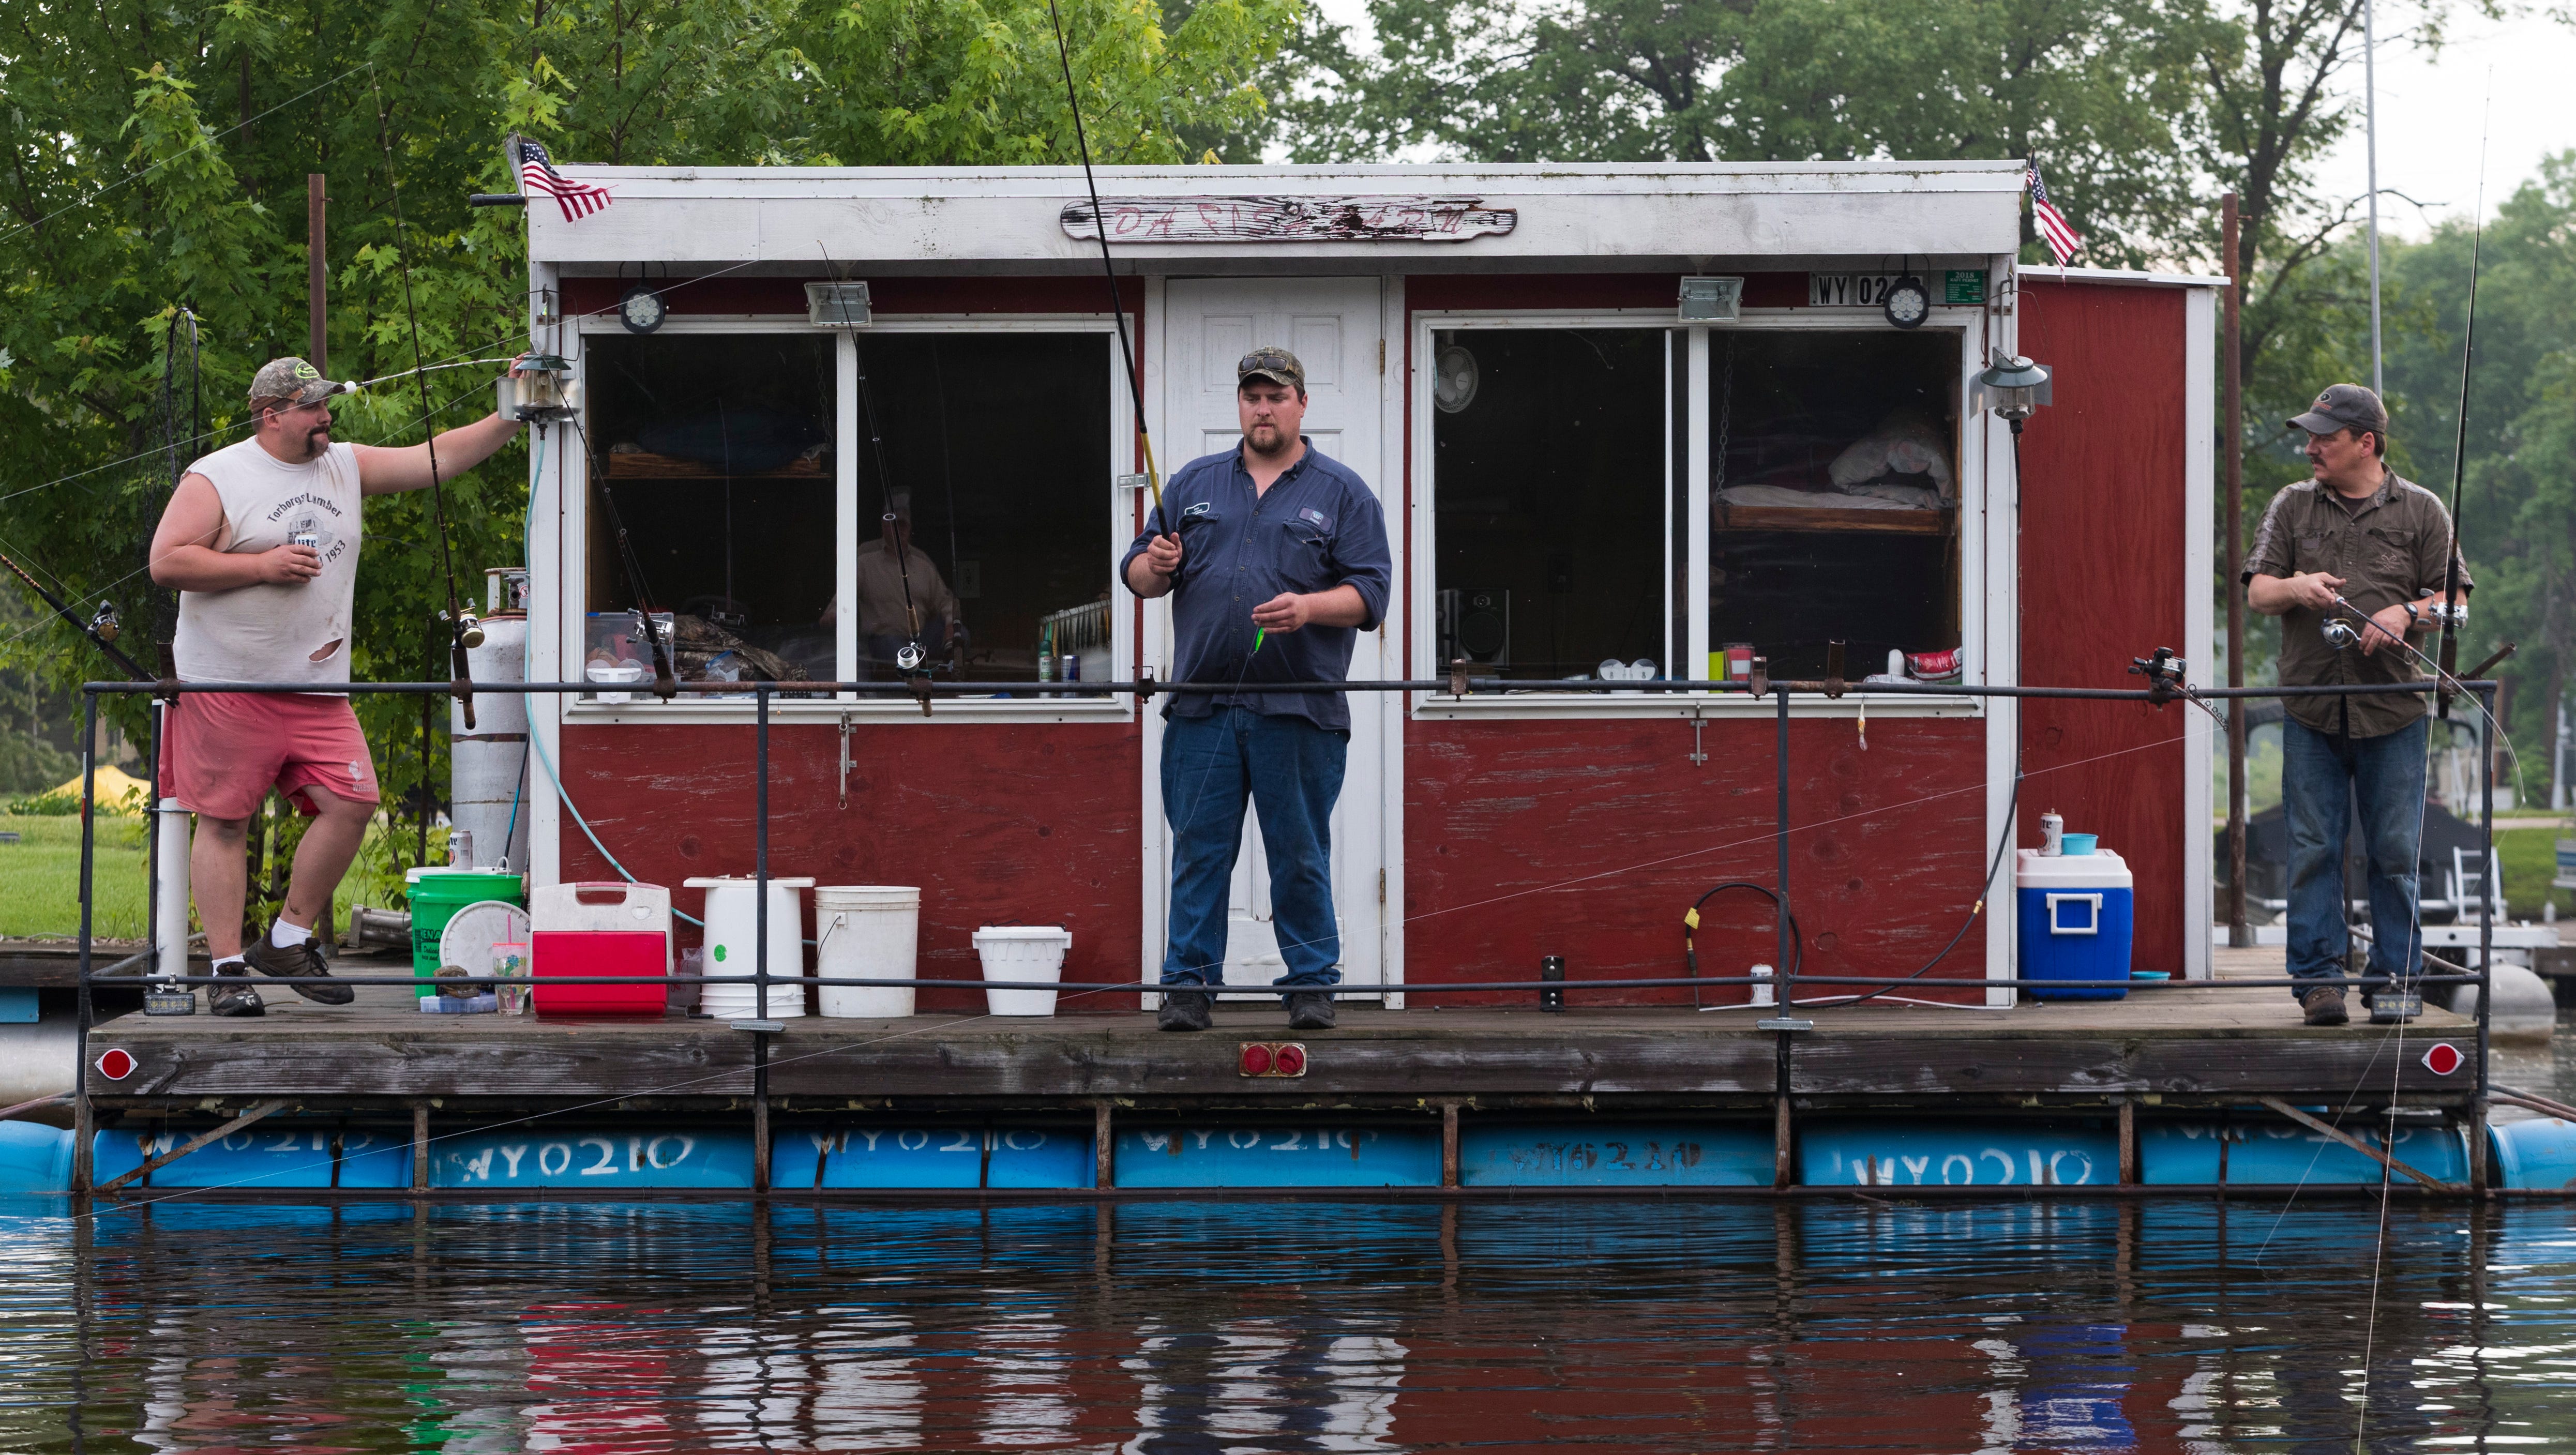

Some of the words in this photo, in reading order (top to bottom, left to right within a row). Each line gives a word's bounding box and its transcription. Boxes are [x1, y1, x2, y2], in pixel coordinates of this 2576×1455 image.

[1818, 276, 1847, 305] WY
[306, 492, 342, 518] Lumber
[325, 540, 346, 563] 1953
